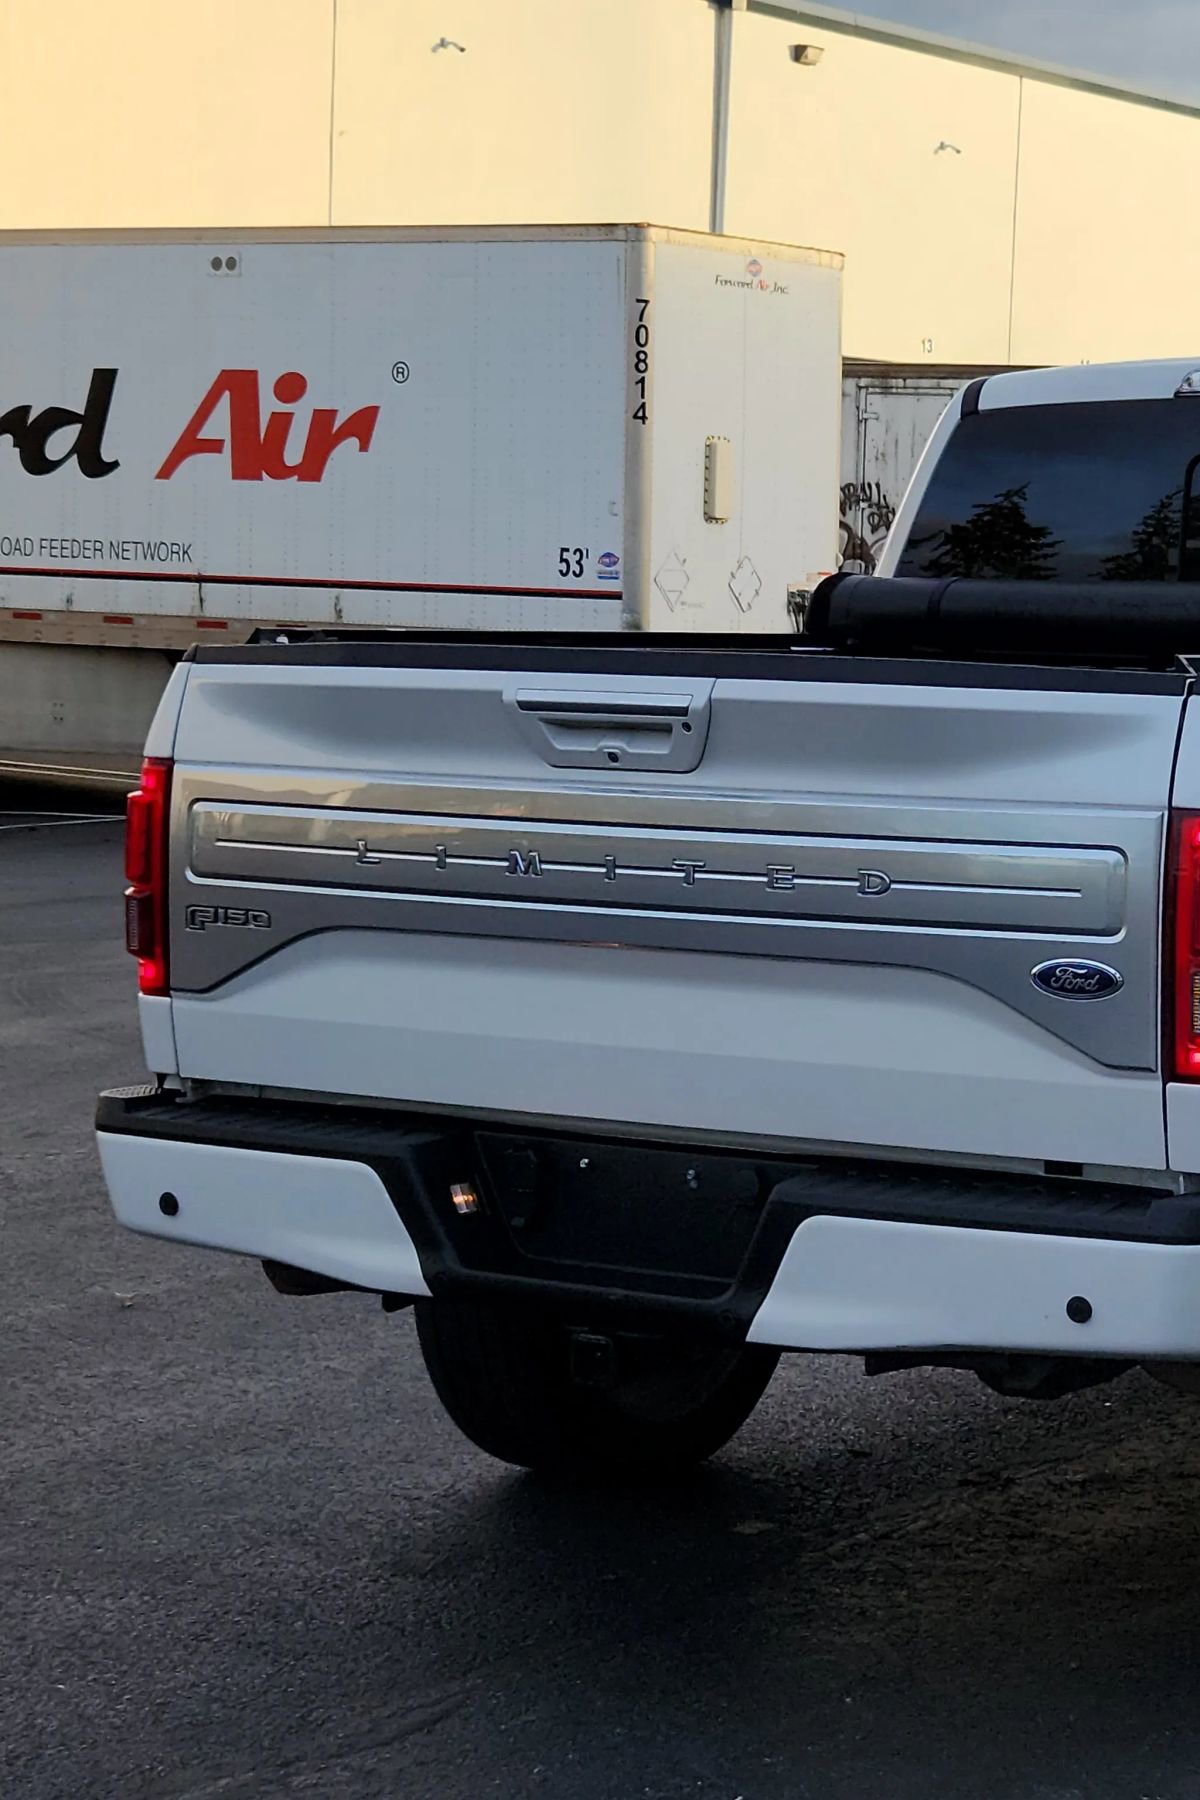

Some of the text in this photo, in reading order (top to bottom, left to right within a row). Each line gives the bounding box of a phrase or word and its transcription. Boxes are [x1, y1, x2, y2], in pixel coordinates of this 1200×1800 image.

[632, 298, 650, 425] 70814
[921, 338, 933, 353] 13
[155, 369, 380, 482] Air
[39, 537, 104, 560] FEEDER
[109, 540, 192, 563] NETWORK
[355, 839, 894, 898] LIMITED
[1050, 966, 1101, 991] Ford
